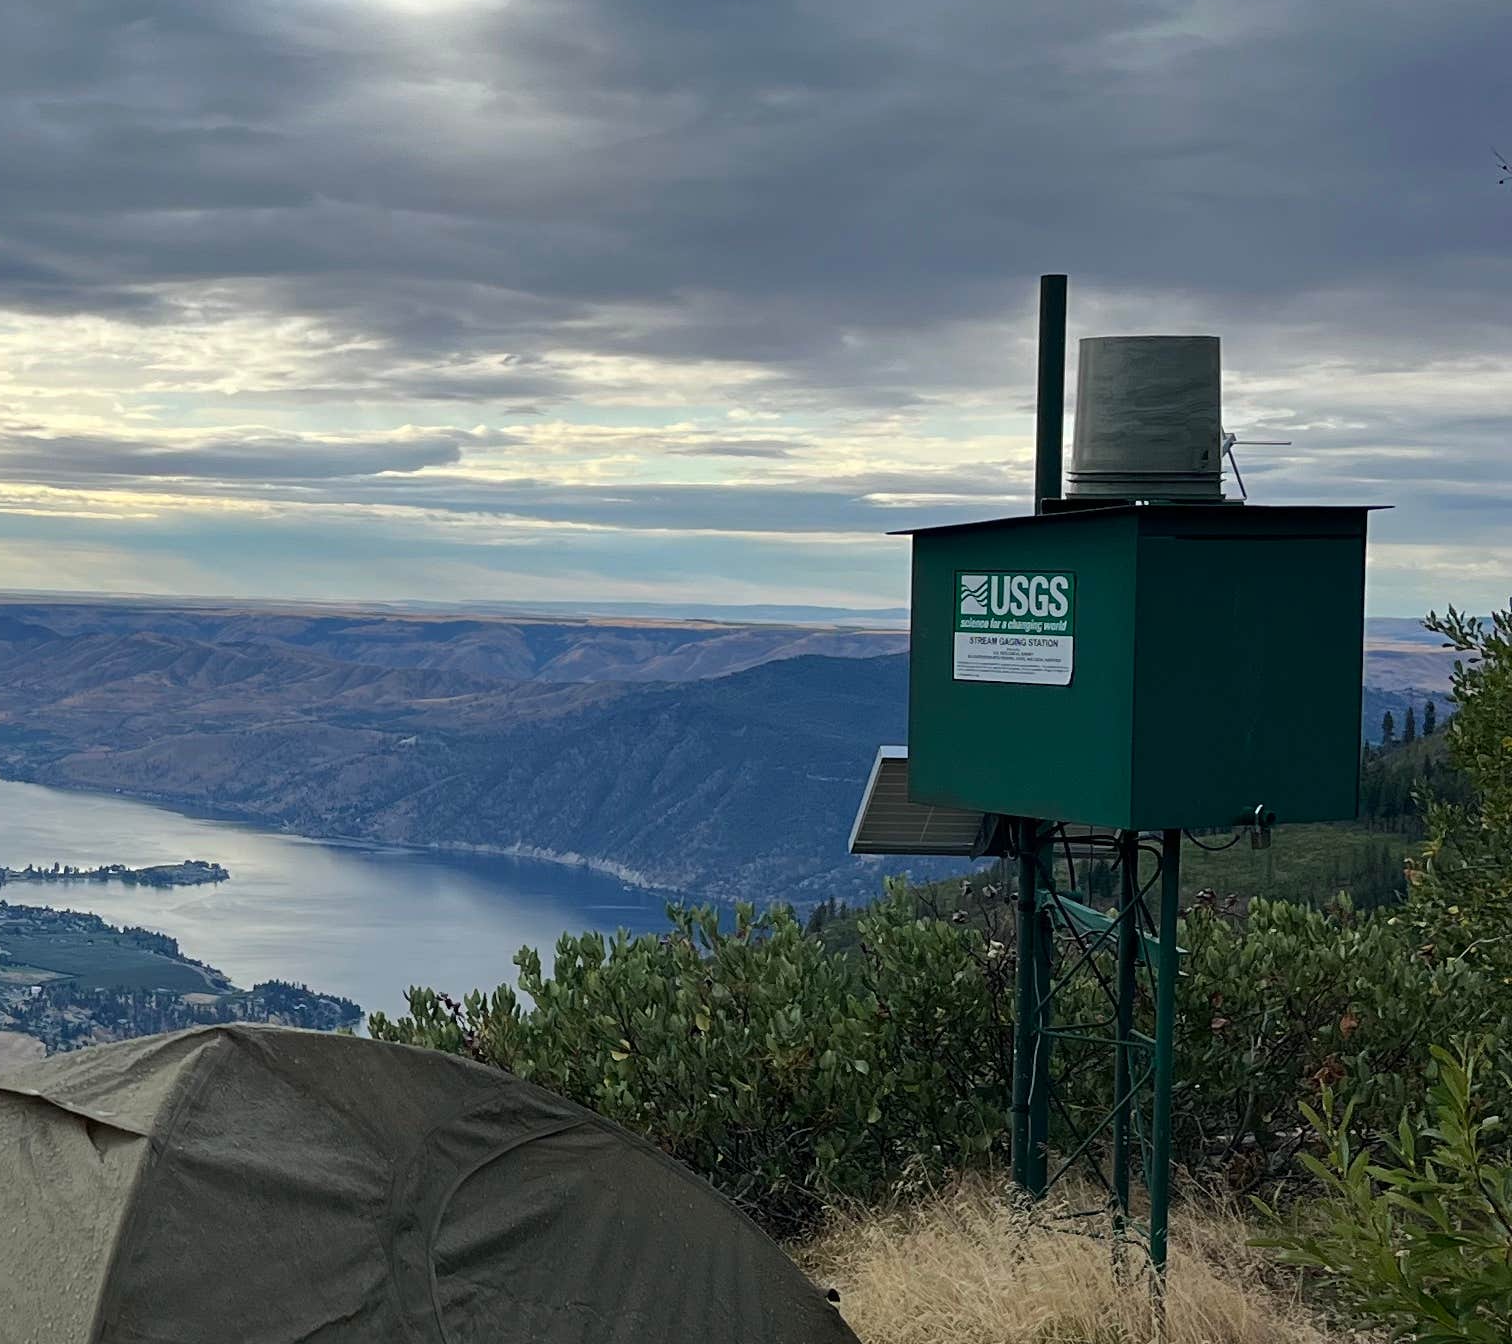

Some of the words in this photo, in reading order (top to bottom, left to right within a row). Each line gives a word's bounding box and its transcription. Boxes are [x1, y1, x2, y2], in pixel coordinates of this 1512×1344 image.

[991, 575, 1069, 617] USGS
[960, 617, 989, 629] science
[990, 617, 1001, 629] for
[1001, 620, 1008, 630] a
[1008, 619, 1043, 632] changing
[1044, 620, 1067, 632] world
[969, 637, 998, 646] STREAM
[999, 637, 1027, 647] GAGING
[1028, 638, 1059, 648] STATION
